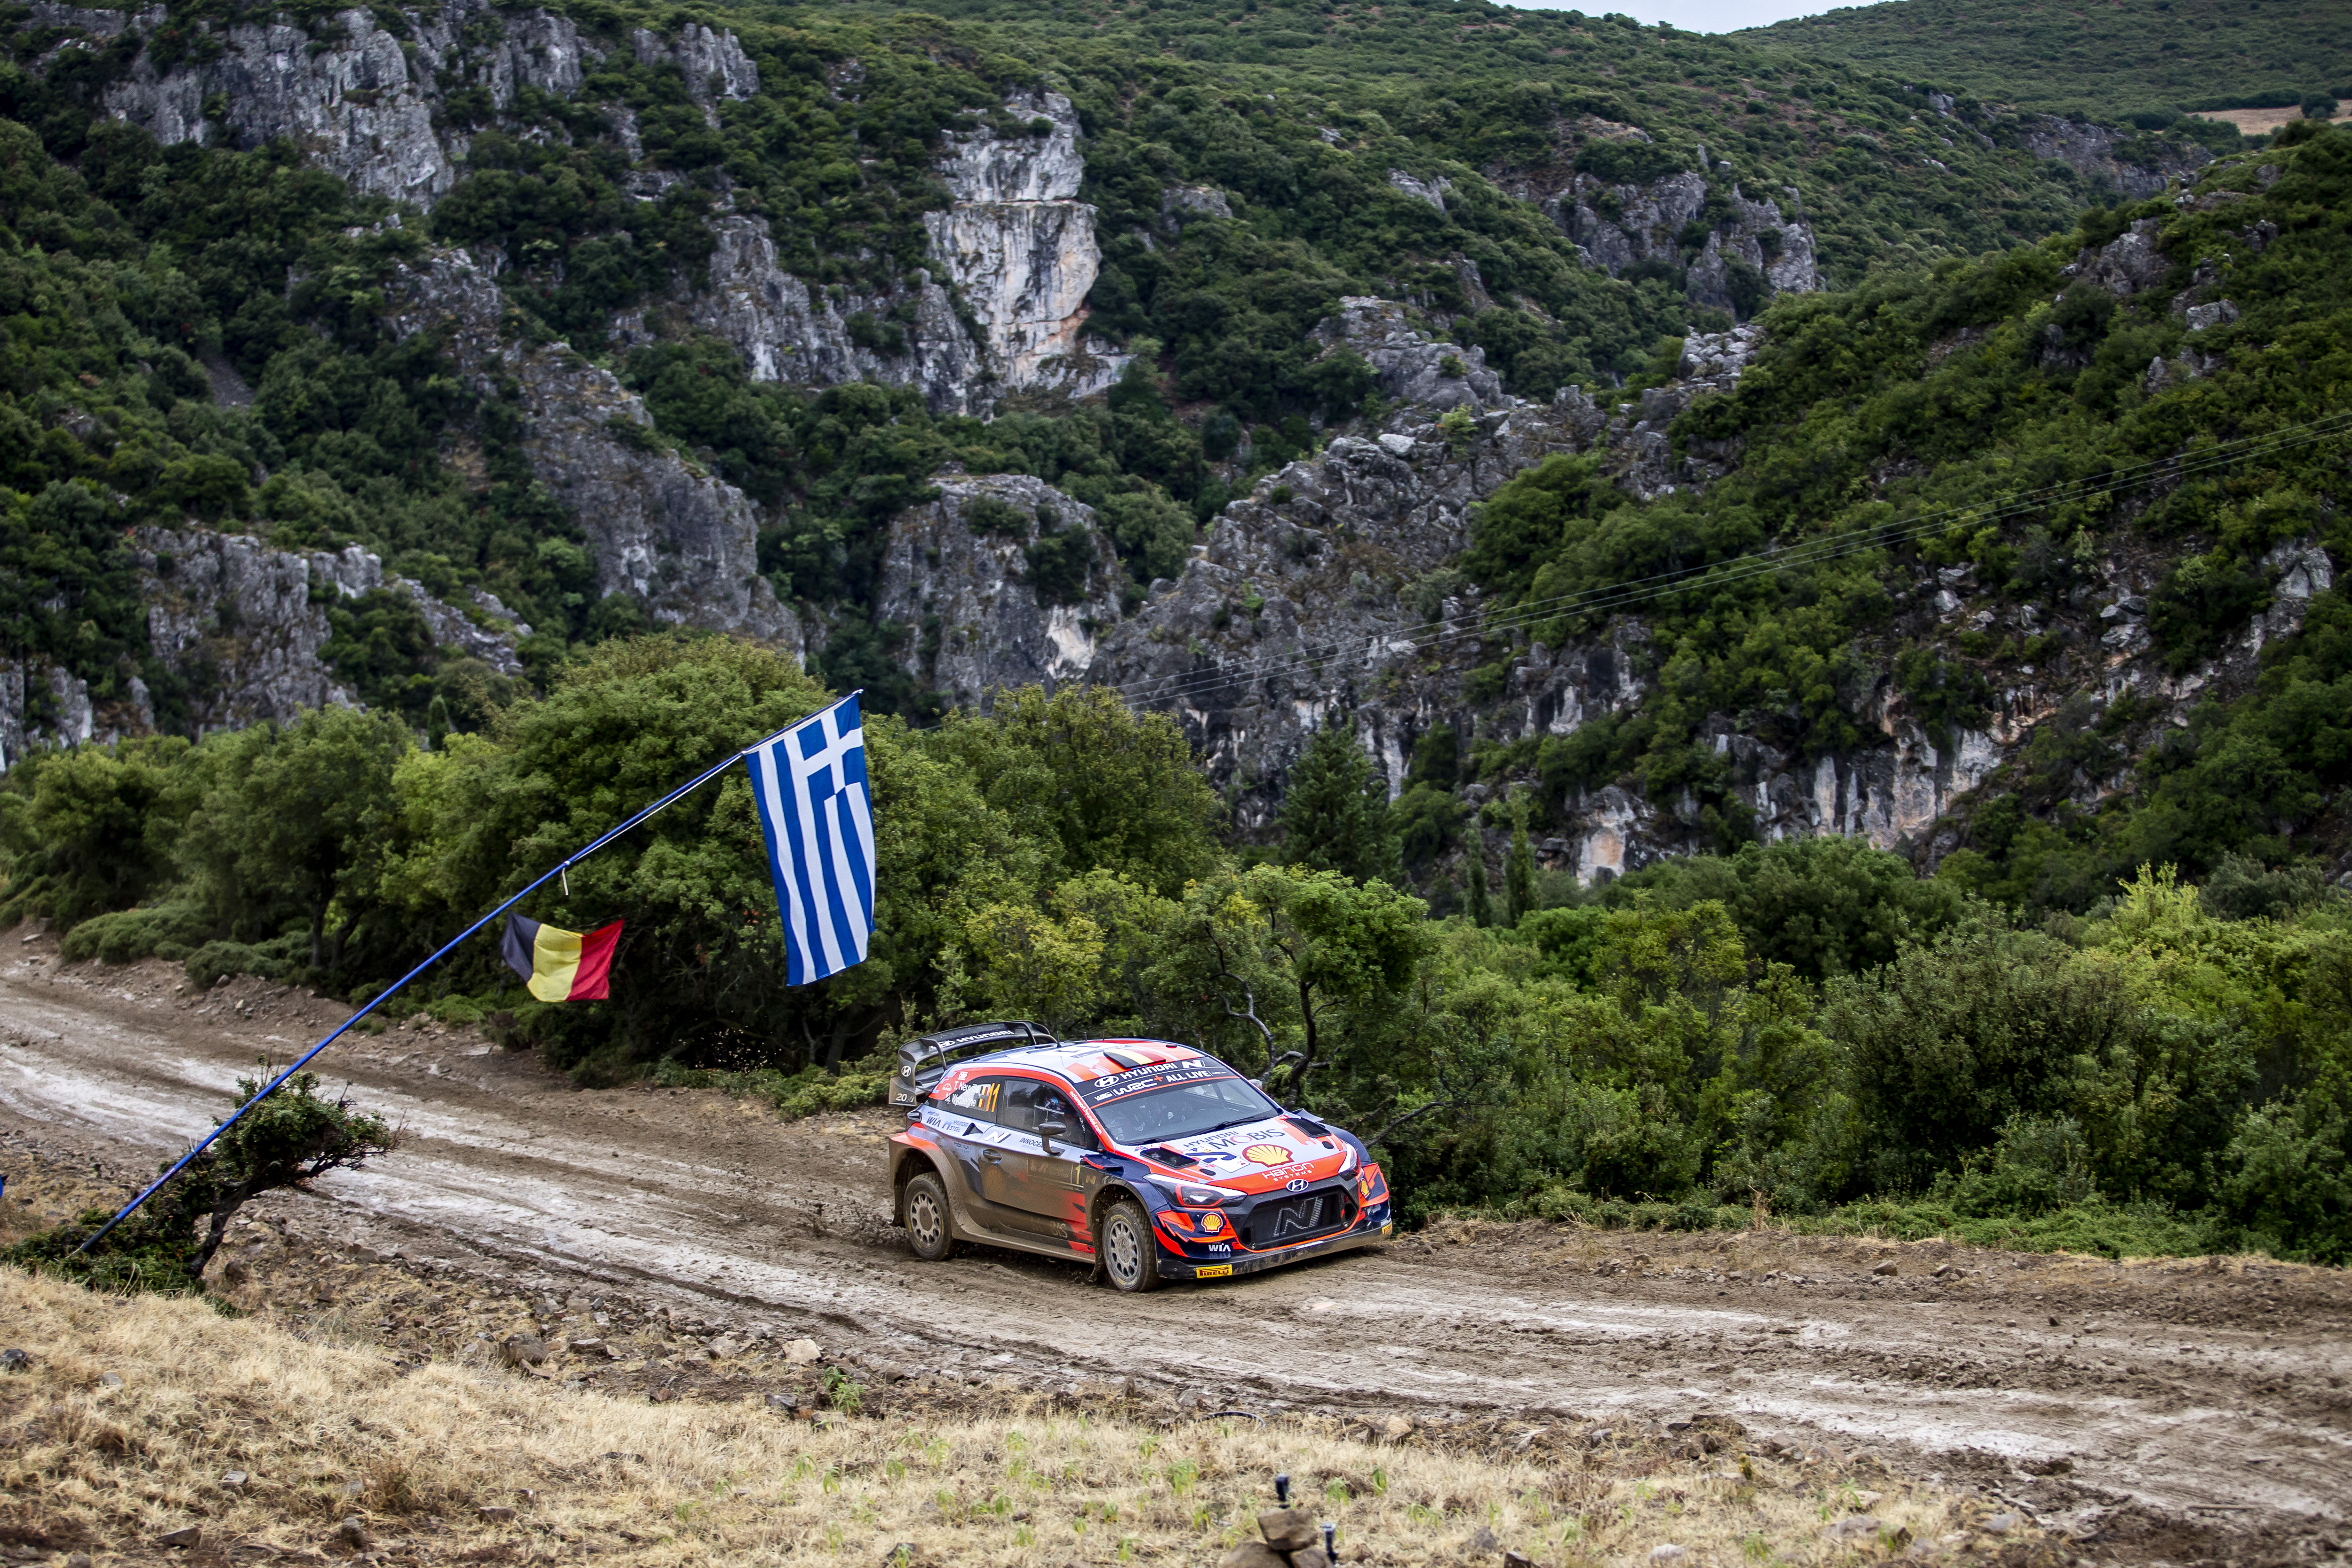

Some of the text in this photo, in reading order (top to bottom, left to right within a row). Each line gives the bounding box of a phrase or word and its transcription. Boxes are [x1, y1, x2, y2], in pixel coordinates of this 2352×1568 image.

[956, 1030, 1014, 1043] HYUNDAI
[1120, 1063, 1178, 1080] HYUNDAI
[1166, 1072, 1187, 1082] ALL
[1188, 1070, 1211, 1079] LIVE
[954, 1081, 959, 1090] T.
[959, 1082, 979, 1093] Neuville
[896, 1093, 907, 1102] 20
[952, 1093, 976, 1108] Wydaeghe
[986, 1083, 1001, 1113] 11
[1069, 1090, 1102, 1135] motorsport.hyundai.com
[1019, 1138, 1042, 1148] INNOCEA
[1183, 1131, 1240, 1148] HYUNDAI
[1210, 1129, 1285, 1150] MOBIS
[1273, 1170, 1312, 1182] SYSTEMS
[1208, 1243, 1231, 1252] WIA
[1199, 1266, 1229, 1276] PIRELLI
